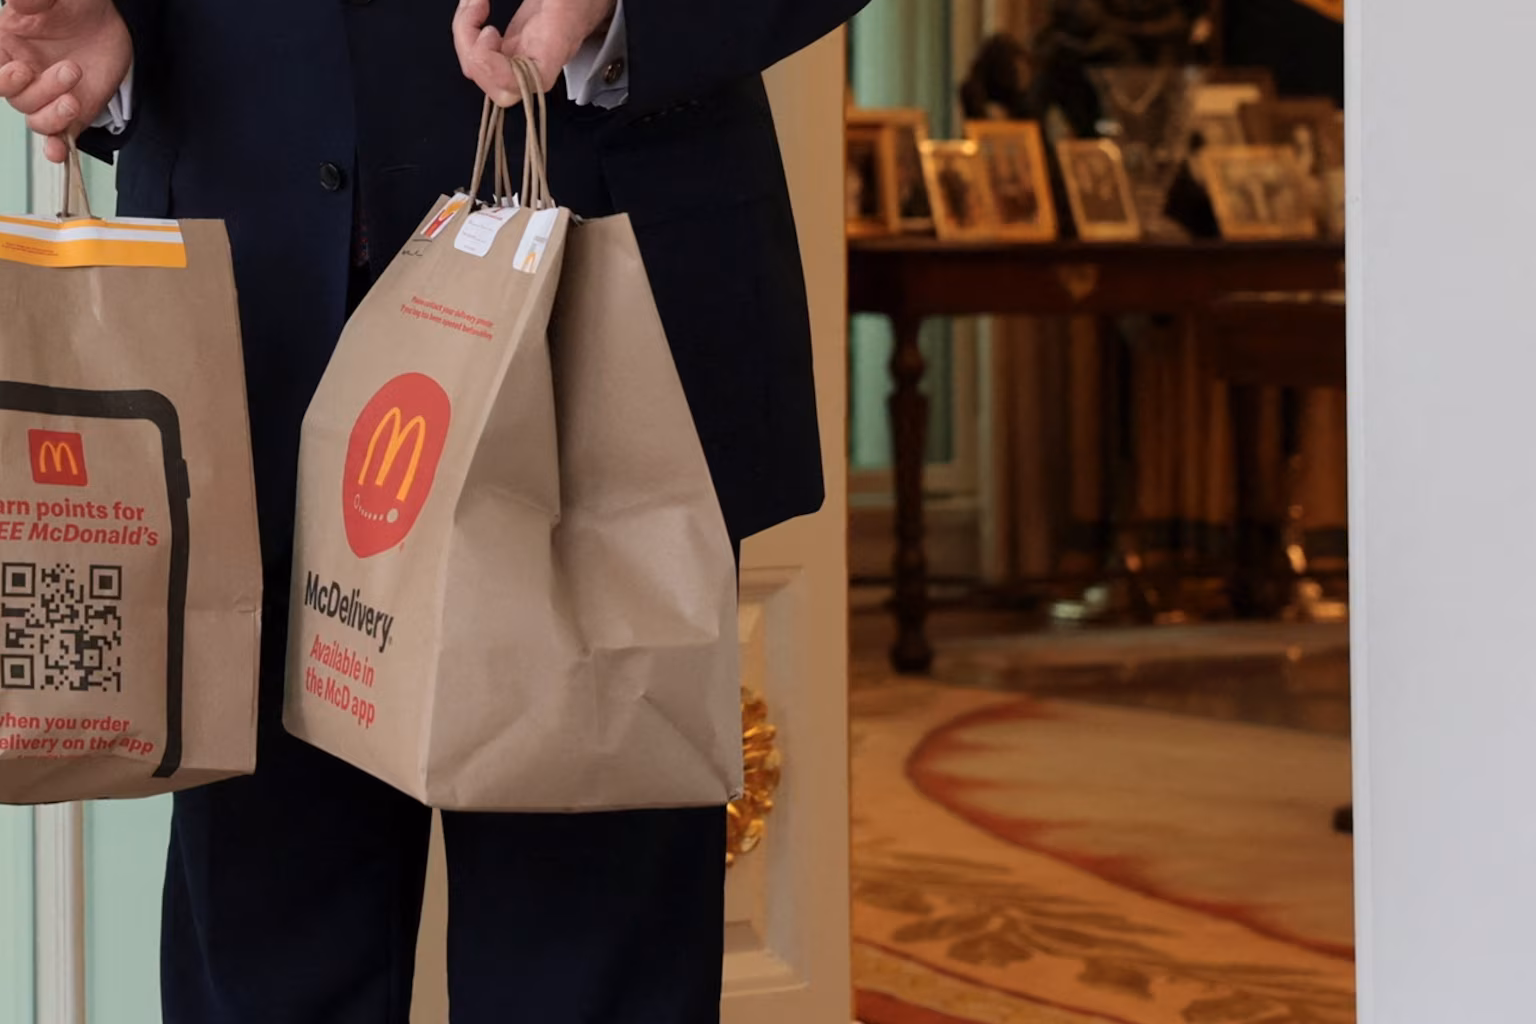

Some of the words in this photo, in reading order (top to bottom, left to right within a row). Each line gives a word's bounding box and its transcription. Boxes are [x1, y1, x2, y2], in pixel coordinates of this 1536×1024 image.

[36, 498, 109, 520] points
[113, 501, 145, 521] for
[28, 523, 159, 546] McDonald's
[304, 570, 394, 653] McDelivery
[309, 634, 362, 680] Available
[362, 656, 375, 688] in
[305, 667, 323, 697] the
[324, 677, 350, 710] McD
[351, 696, 375, 729] app
[44, 716, 77, 733] you
[81, 716, 131, 732] order
[62, 737, 85, 750] on
[118, 736, 154, 755] app
